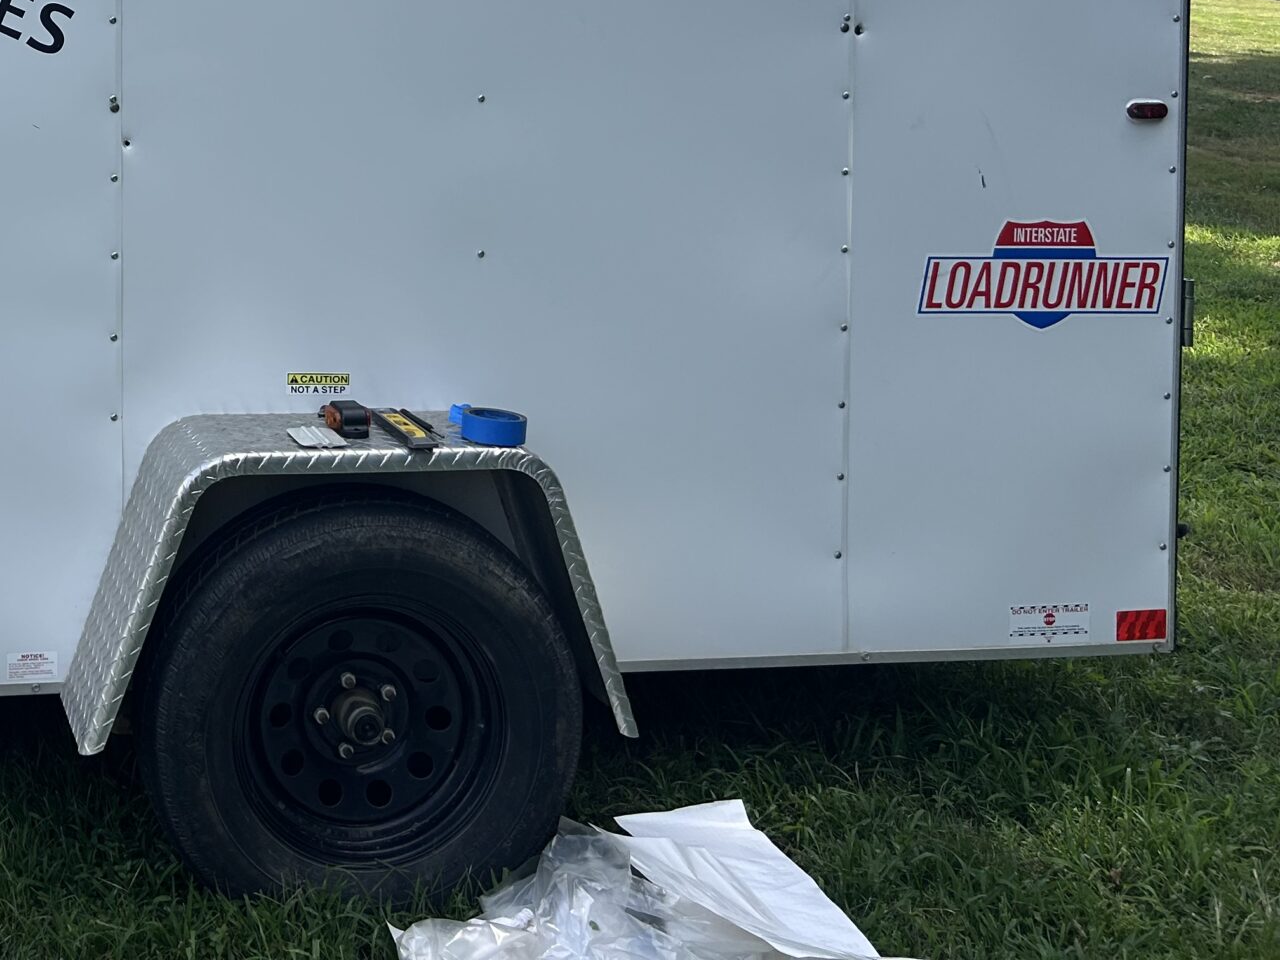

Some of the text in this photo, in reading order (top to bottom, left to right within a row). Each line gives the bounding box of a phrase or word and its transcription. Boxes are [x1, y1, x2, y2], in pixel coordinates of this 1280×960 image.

[1013, 227, 1078, 244] INTERSTATE
[925, 261, 1161, 309] LOADRUNNER
[300, 375, 348, 384] CAUTION
